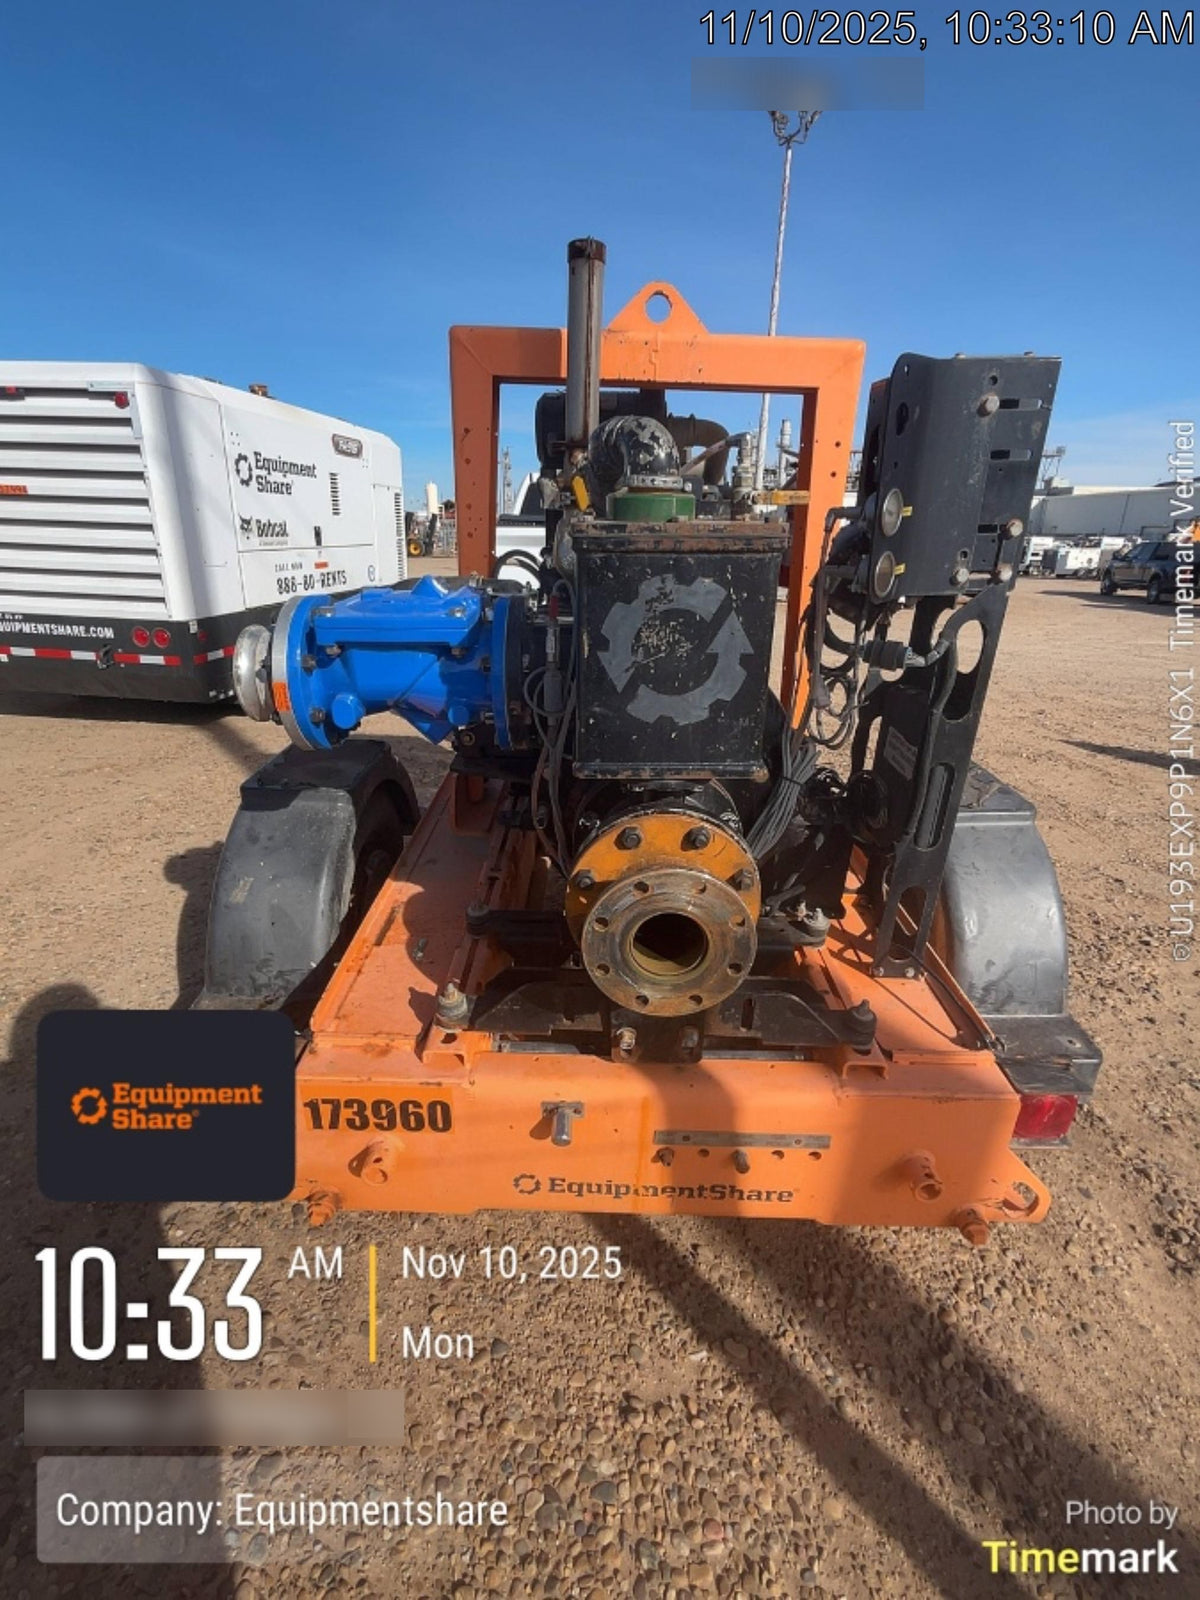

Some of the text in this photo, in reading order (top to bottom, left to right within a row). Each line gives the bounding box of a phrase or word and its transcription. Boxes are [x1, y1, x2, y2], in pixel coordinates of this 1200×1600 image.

[254, 451, 317, 479] Equipment
[255, 518, 289, 538] Bobcat
[304, 1098, 452, 1133] 173960
